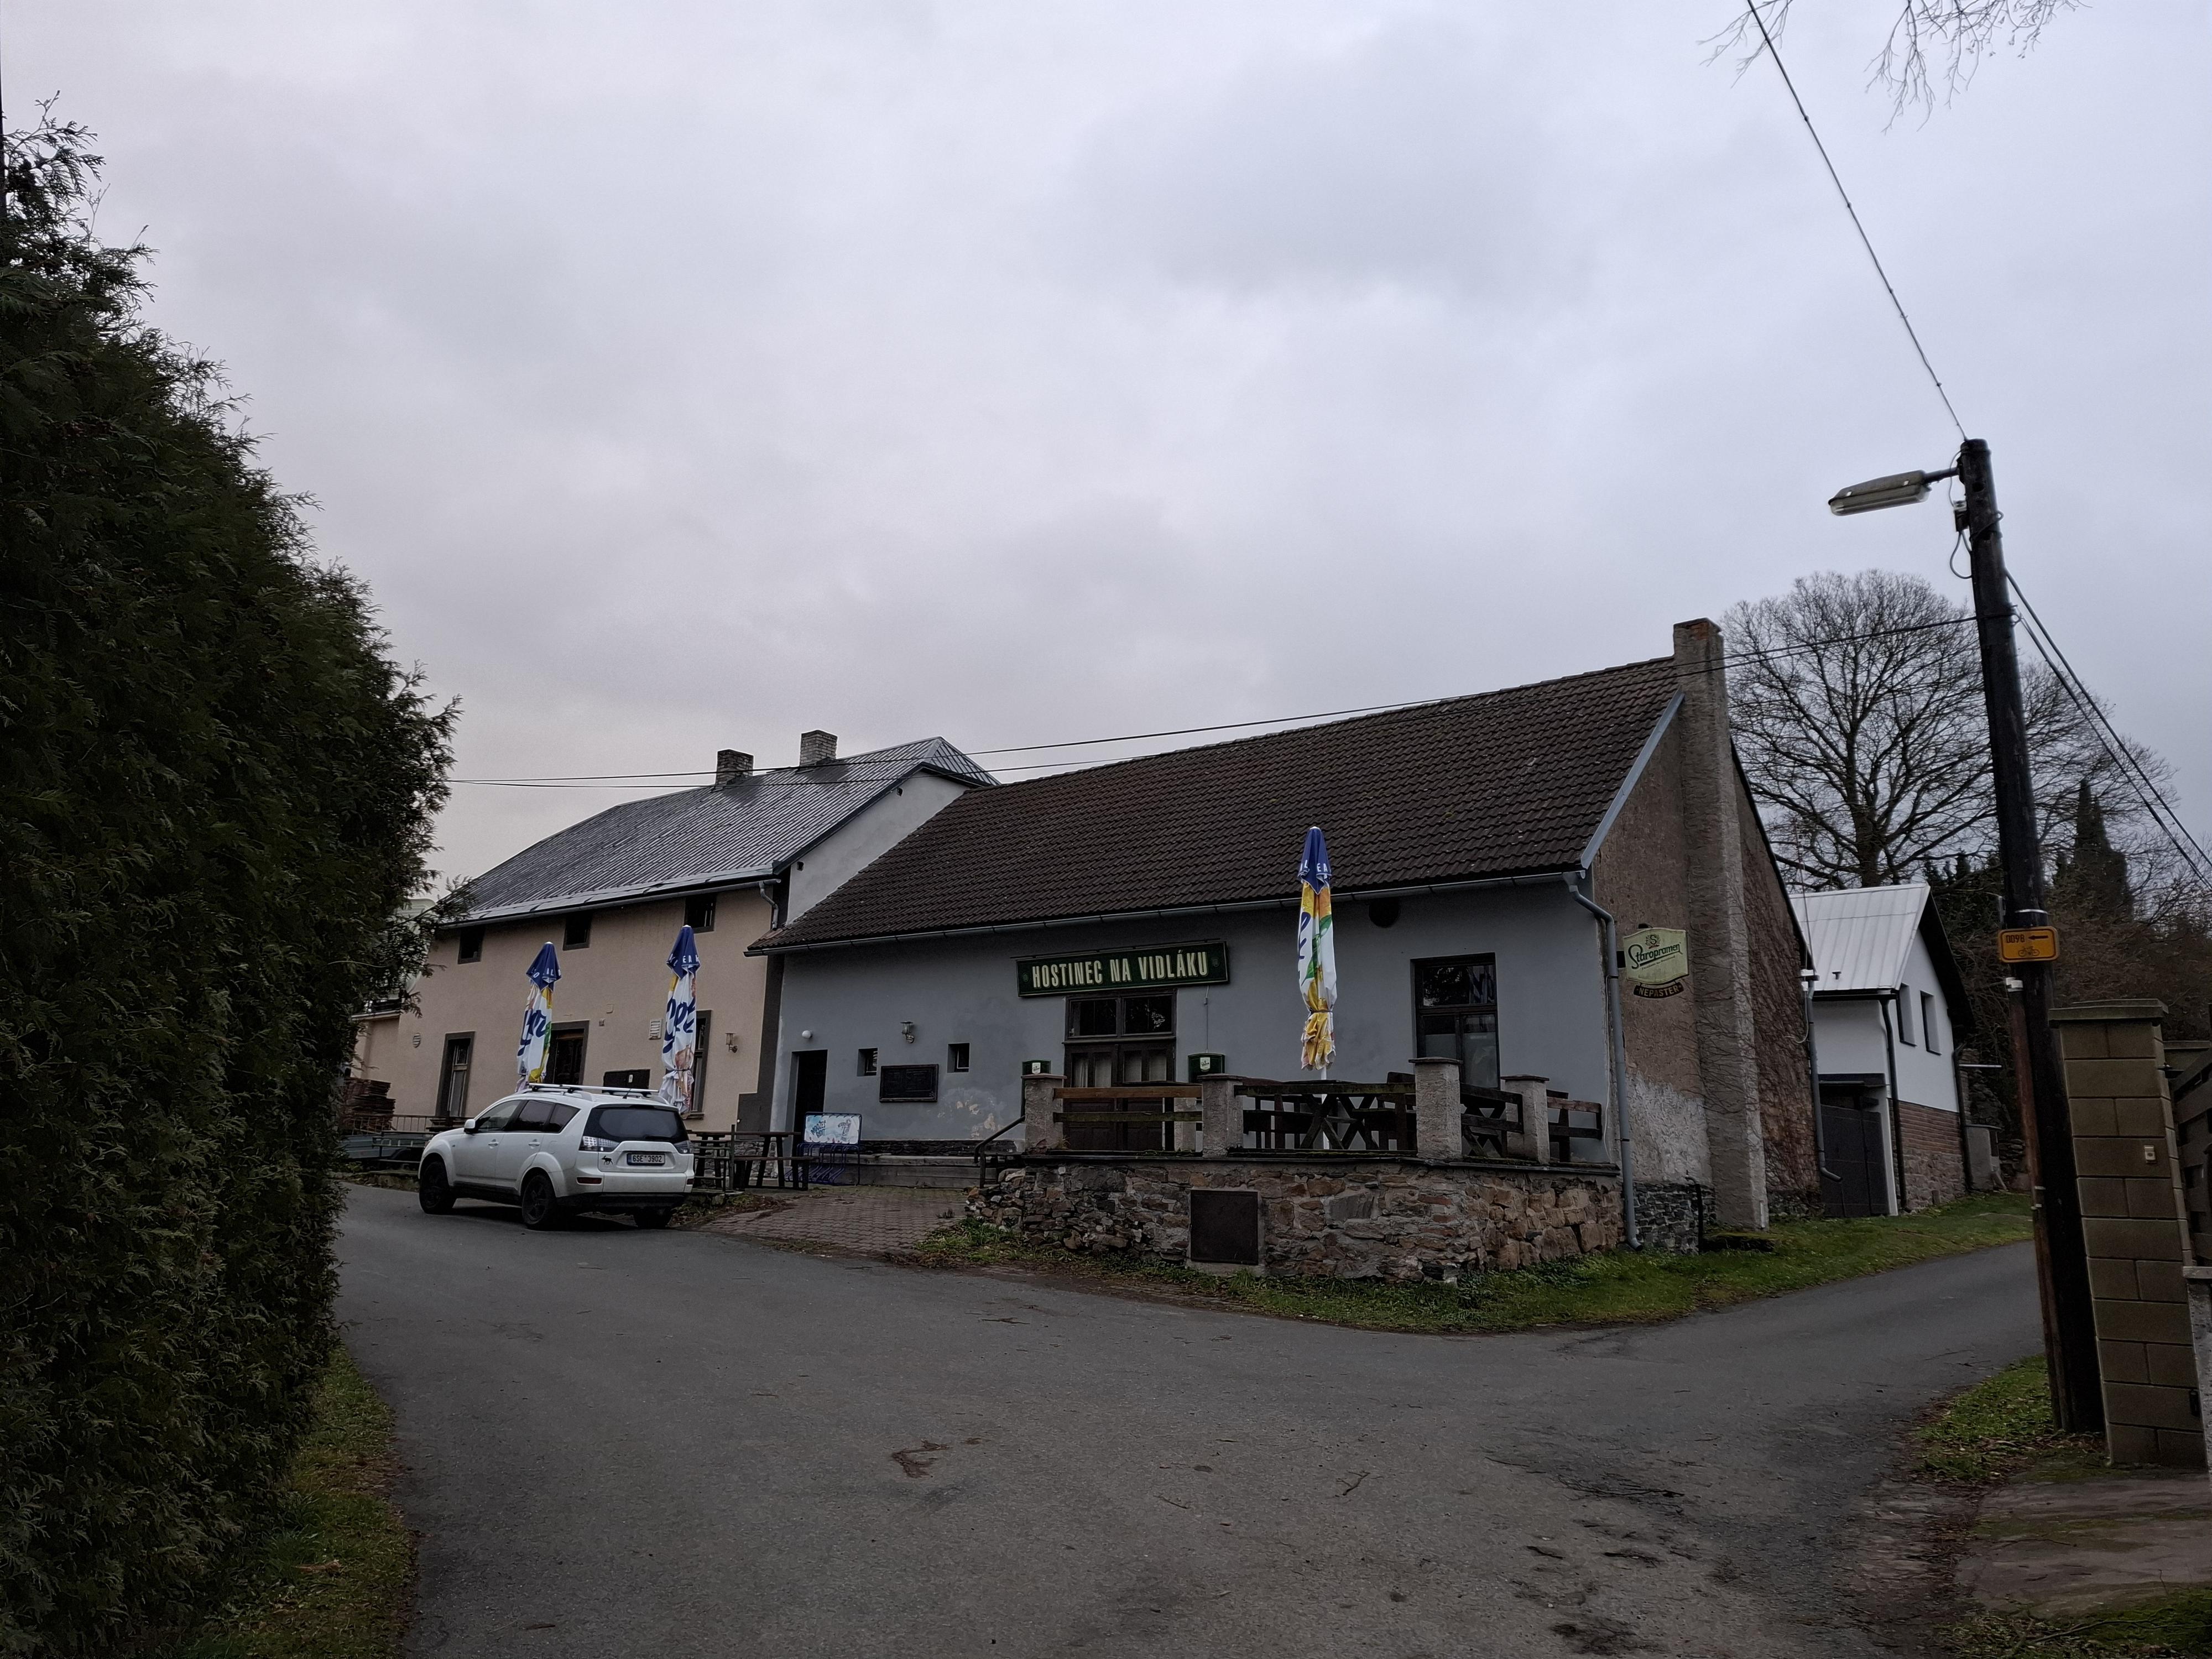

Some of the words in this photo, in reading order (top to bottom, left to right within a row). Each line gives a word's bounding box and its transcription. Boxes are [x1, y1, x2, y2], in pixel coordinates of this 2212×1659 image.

[2006, 934, 2025, 943] 0098
[1628, 942, 1681, 969] Staropramen
[1032, 961, 1103, 988] HOSTINEC
[1109, 958, 1132, 982] NA
[1138, 950, 1209, 979] VIDLÁKU
[1639, 986, 1679, 997] NEPASTER
